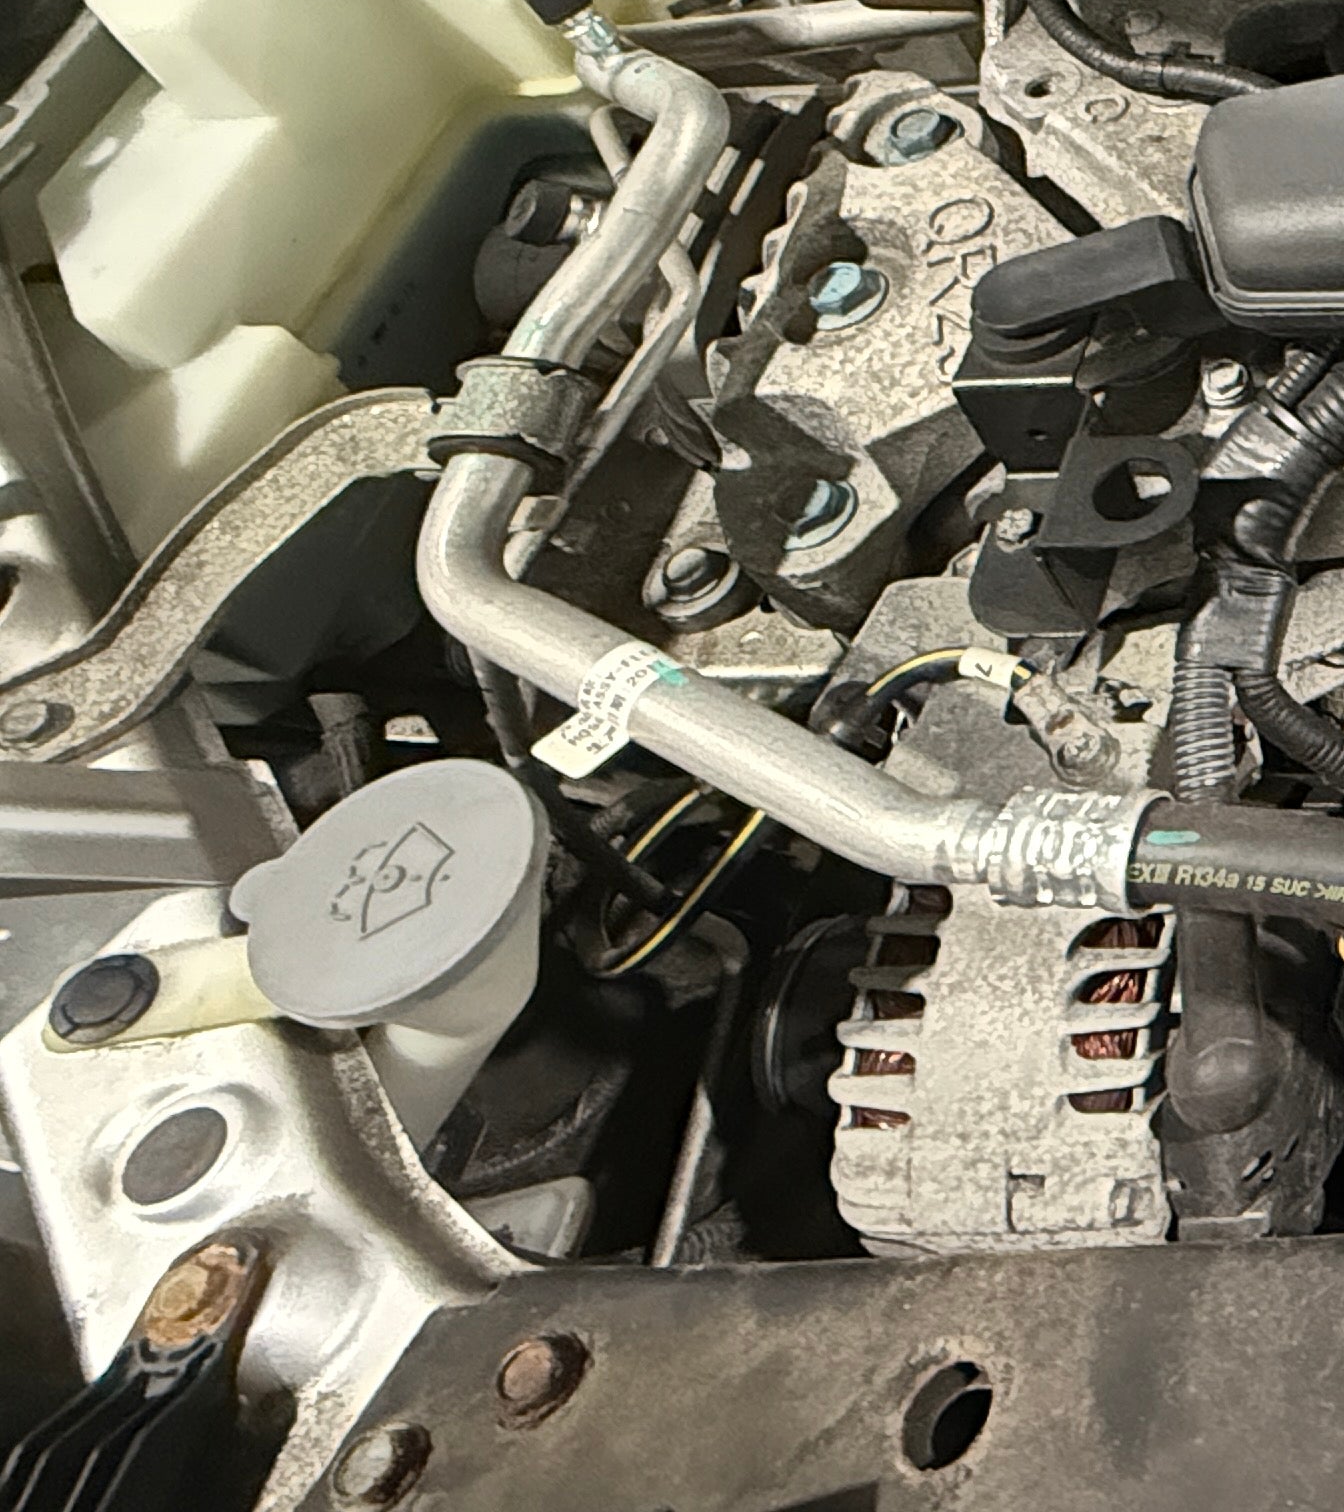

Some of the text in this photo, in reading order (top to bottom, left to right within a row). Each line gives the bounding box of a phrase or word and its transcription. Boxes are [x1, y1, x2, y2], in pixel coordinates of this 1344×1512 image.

[1174, 864, 1240, 889] R134a
[1246, 875, 1267, 892] 15
[1270, 877, 1312, 897] SUC
